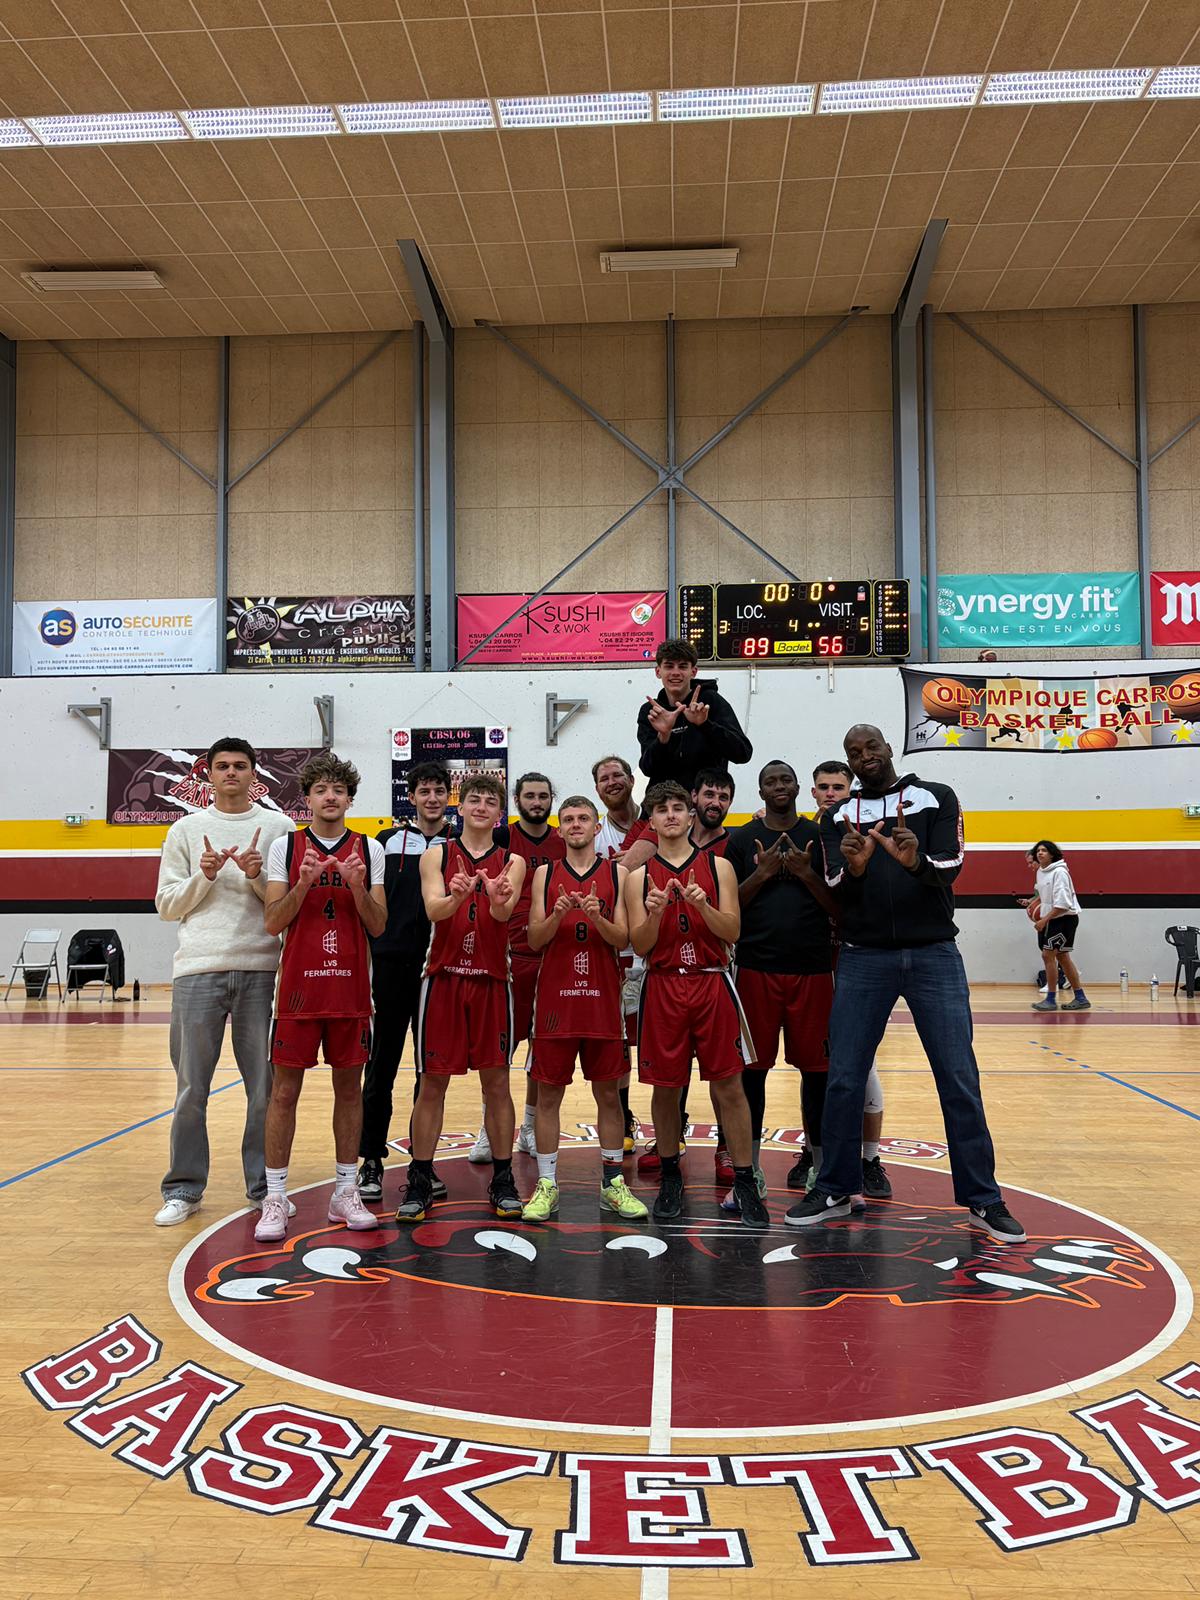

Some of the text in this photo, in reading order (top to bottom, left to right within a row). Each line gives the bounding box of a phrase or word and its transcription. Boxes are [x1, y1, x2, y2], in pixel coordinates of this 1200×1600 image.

[293, 600, 411, 624] ALPHA
[736, 604, 766, 619] LOC.
[818, 602, 855, 617] VISIT.
[44, 619, 73, 637] as
[552, 624, 591, 634] & WOK
[788, 619, 799, 632] 4
[860, 616, 869, 631] 5
[959, 625, 1010, 634] FORME
[1019, 625, 1045, 634] EST
[1054, 624, 1072, 633] EN
[1081, 623, 1121, 633] VOUS
[82, 629, 193, 638] CONTRÔLE TECHNIQUE
[340, 647, 369, 655] ENSEIGNES
[743, 637, 769, 656] 89
[777, 642, 810, 652] Bodet
[818, 636, 843, 654] 56
[936, 680, 1200, 708] OLYMPIQUE CARROS
[959, 709, 1181, 729] BASKET BALL
[429, 730, 471, 740] CBSL 06
[323, 899, 336, 920] 4
[468, 902, 477, 922] 6
[679, 913, 690, 934] 9
[575, 921, 588, 942] 8
[459, 959, 472, 967] LVS
[304, 969, 352, 978] FERMETURES
